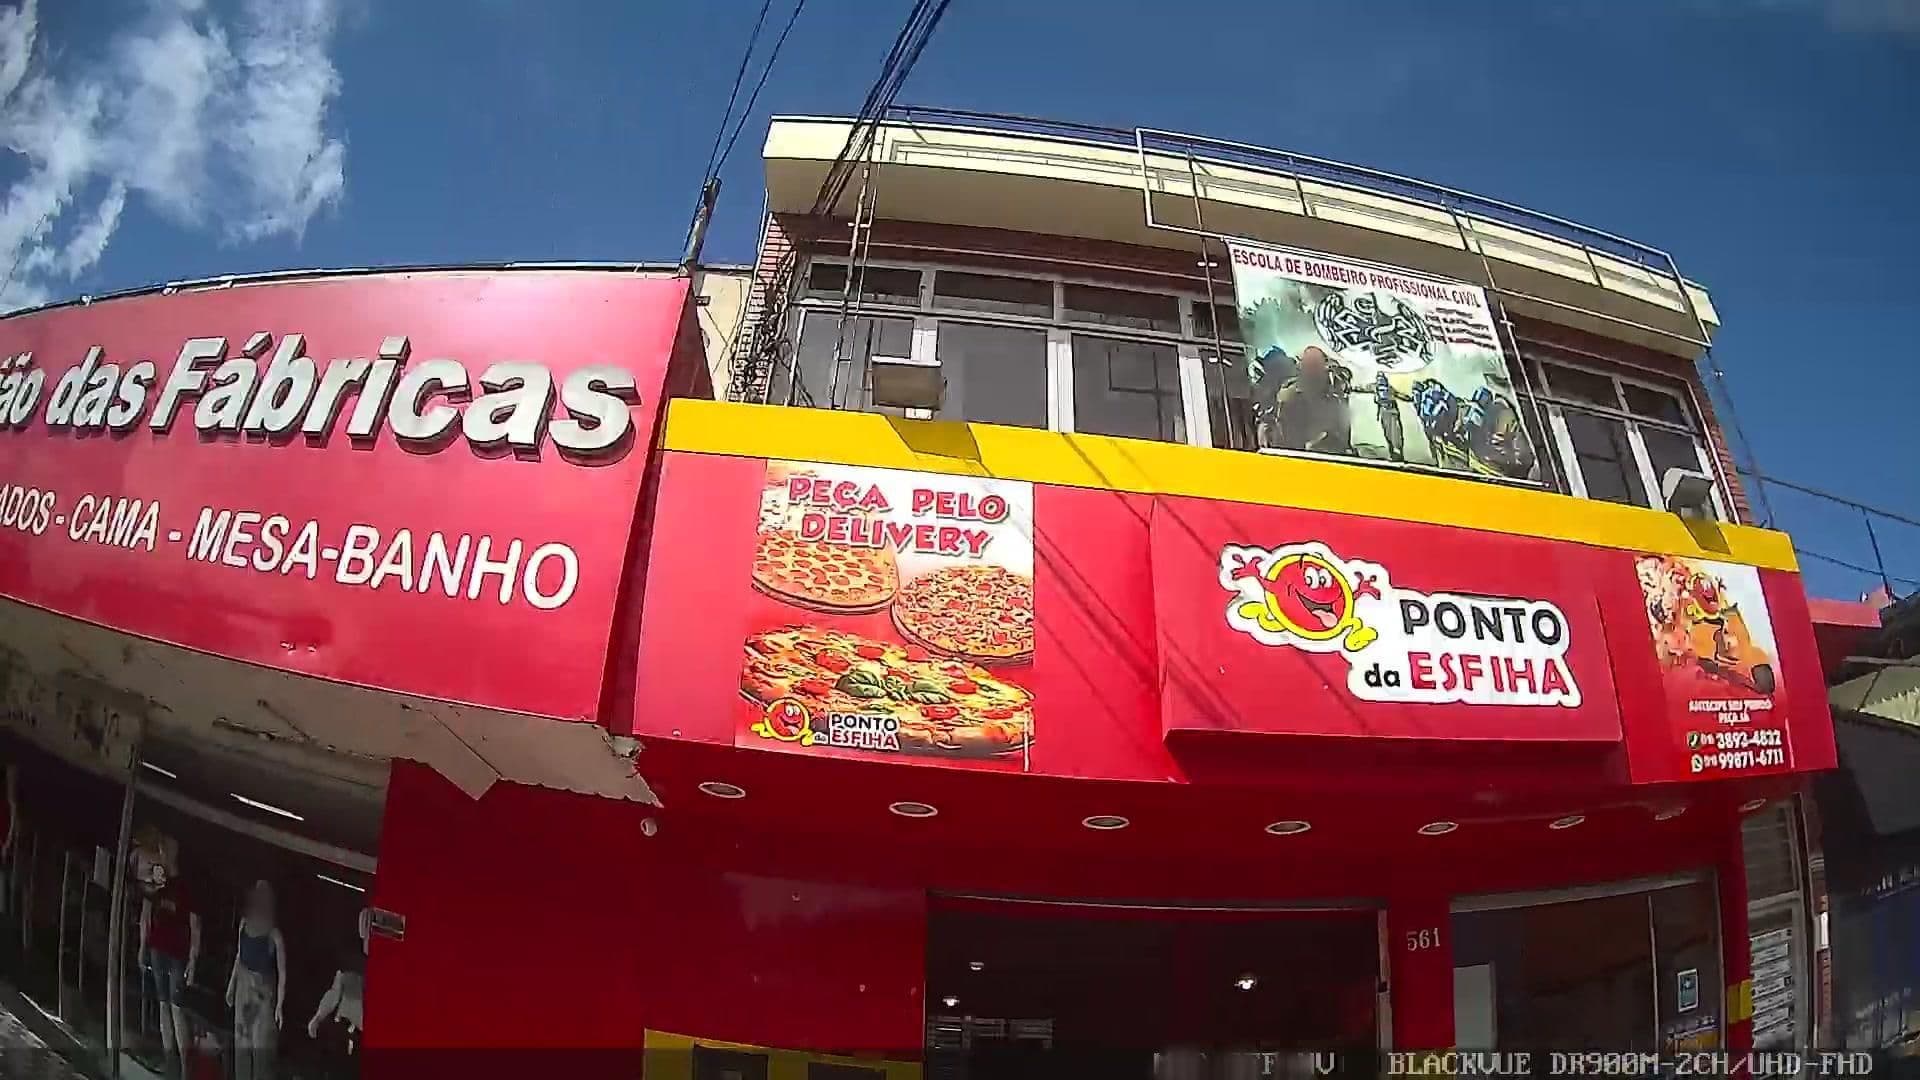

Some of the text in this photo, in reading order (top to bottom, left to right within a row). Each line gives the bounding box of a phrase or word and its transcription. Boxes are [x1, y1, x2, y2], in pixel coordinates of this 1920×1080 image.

[1233, 248, 1481, 308] ESCOLA DE BOMBEIRO PROFISSIONAL CIVIL
[46, 344, 156, 429] das
[150, 333, 640, 460] Fábricas
[68, 494, 160, 550] CAMA
[911, 488, 1008, 521] PELO
[800, 512, 991, 555] DELIVERY
[1399, 599, 1562, 646] PONTO
[1363, 650, 1570, 695] da ESFIHA
[831, 713, 897, 731] PONTO
[831, 730, 897, 748] ESFIHA
[1407, 927, 1441, 951] 561
